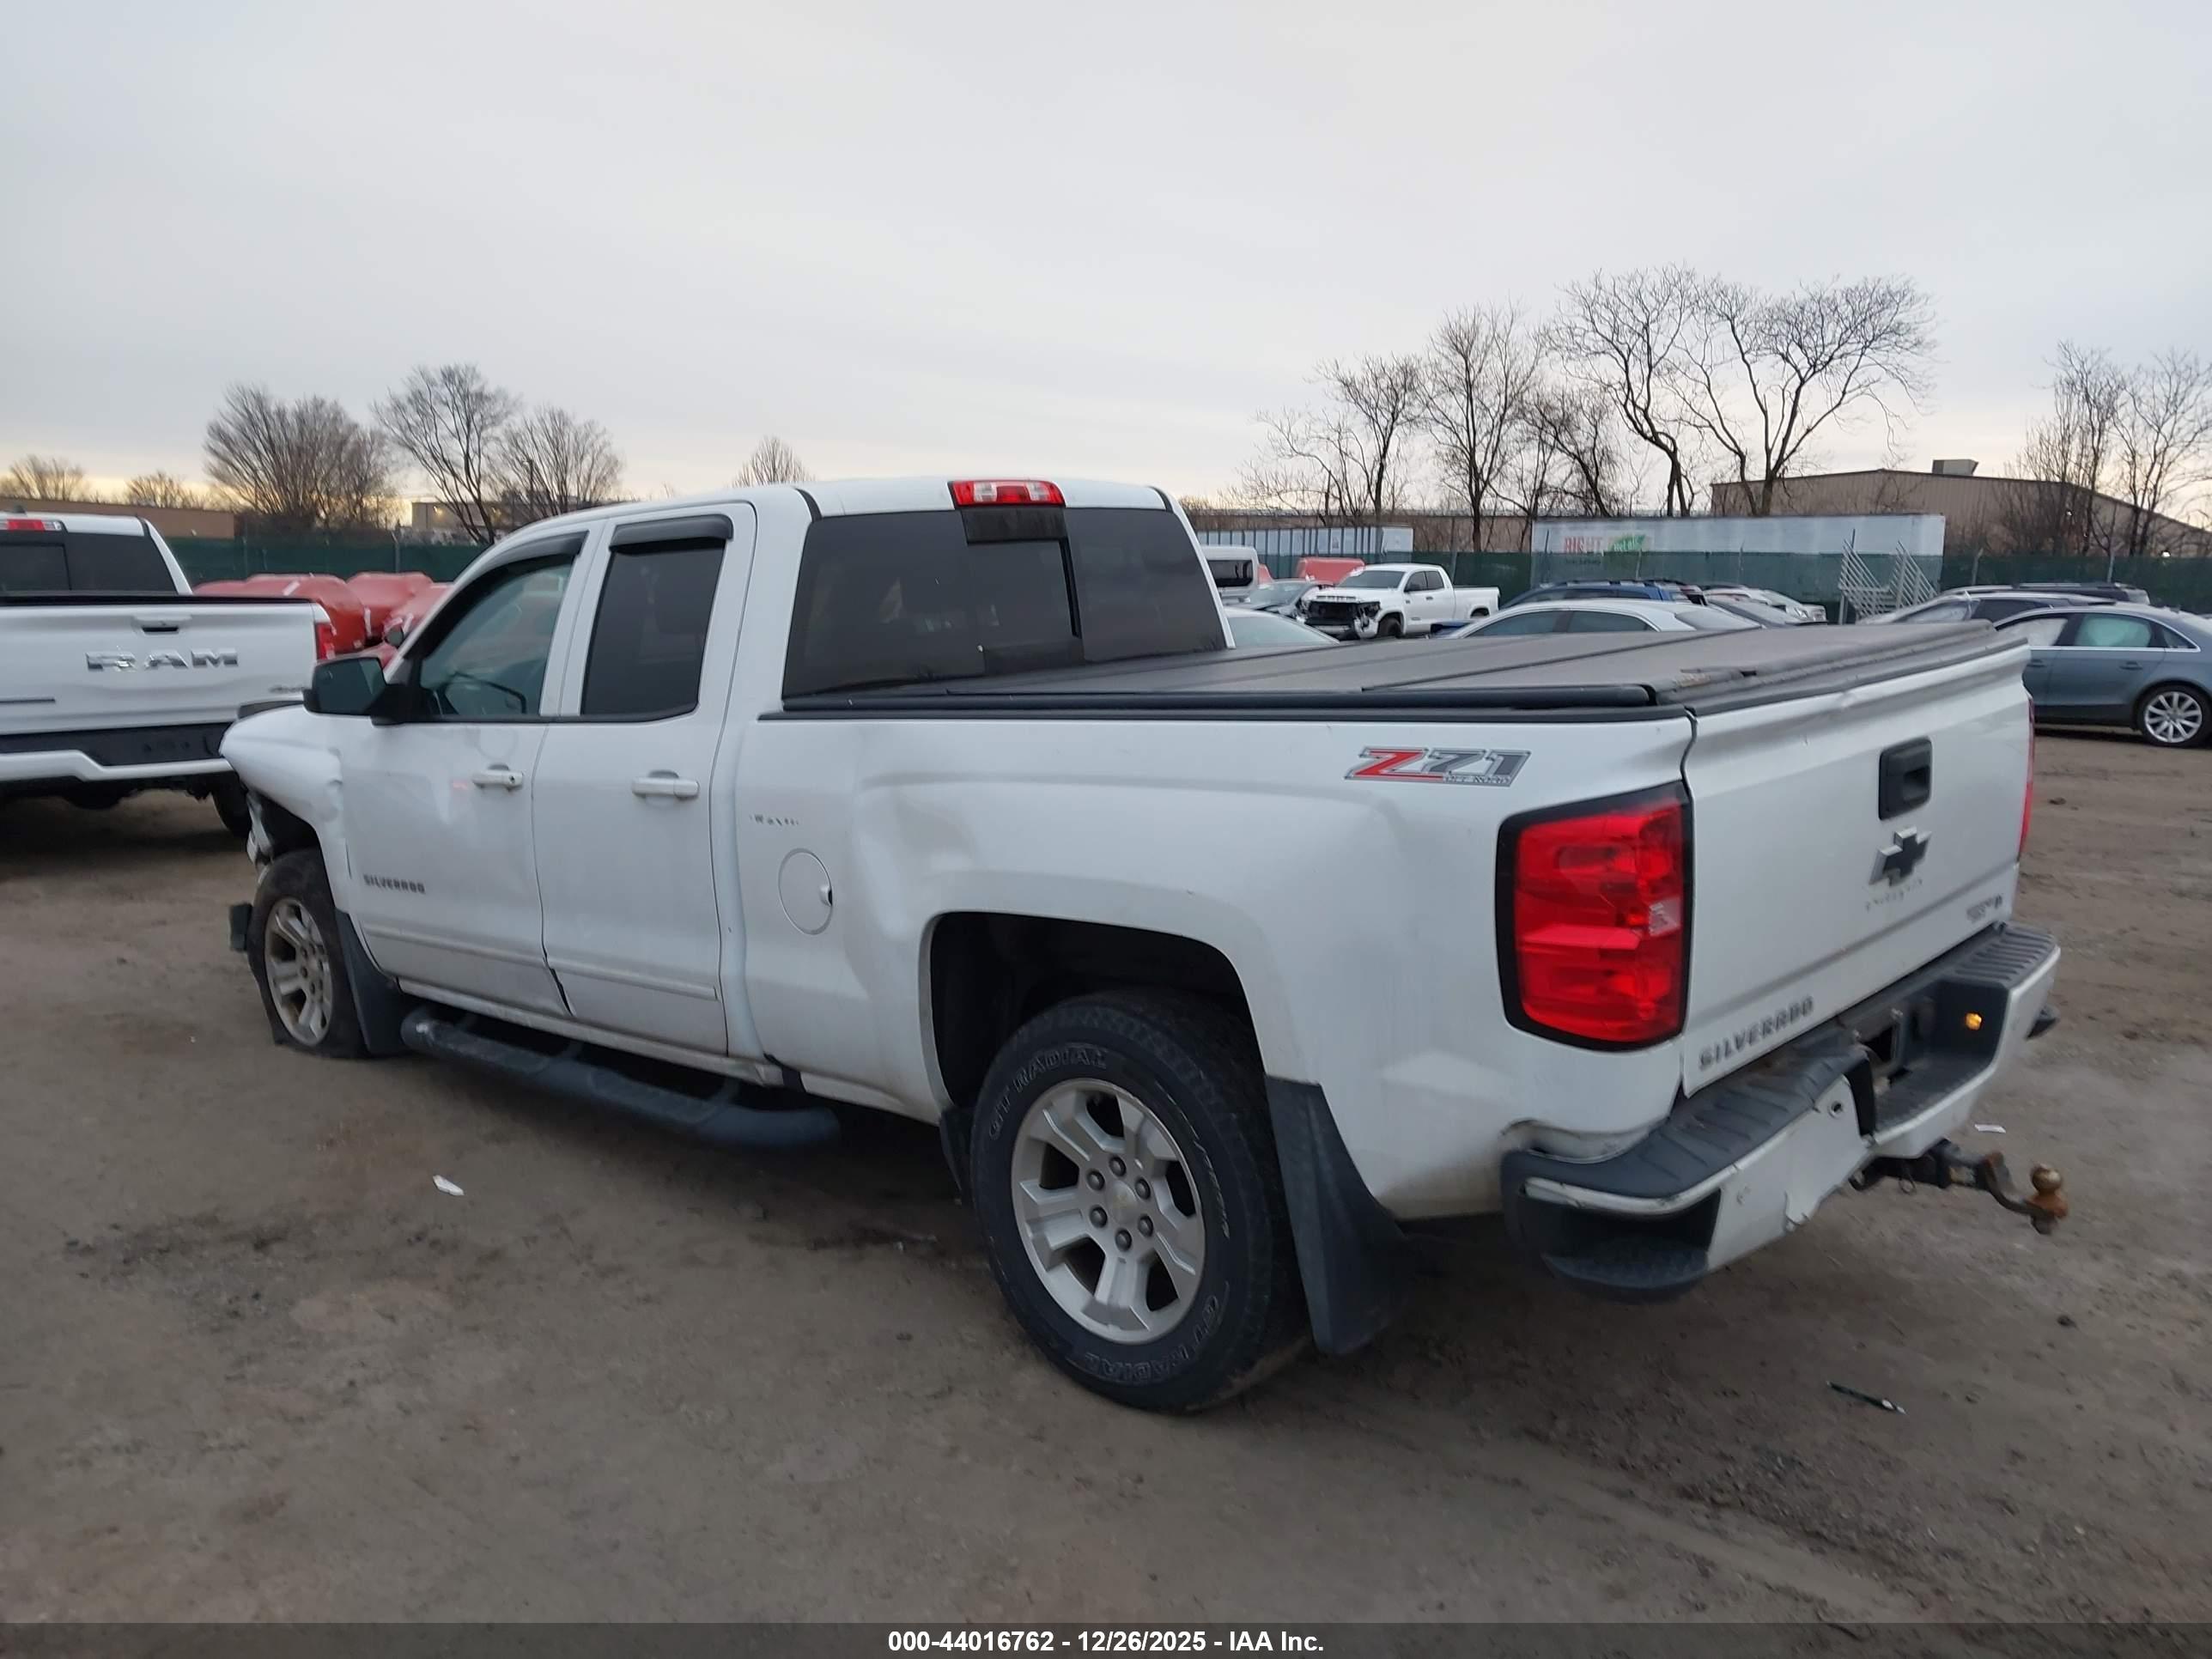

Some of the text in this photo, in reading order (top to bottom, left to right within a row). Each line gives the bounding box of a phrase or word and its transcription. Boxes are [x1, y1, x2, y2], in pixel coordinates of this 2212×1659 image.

[86, 647, 239, 672] RAM
[1345, 746, 1532, 787] Z71
[363, 874, 427, 894] SILVERADO
[1698, 995, 1814, 1071] SILVERADO
